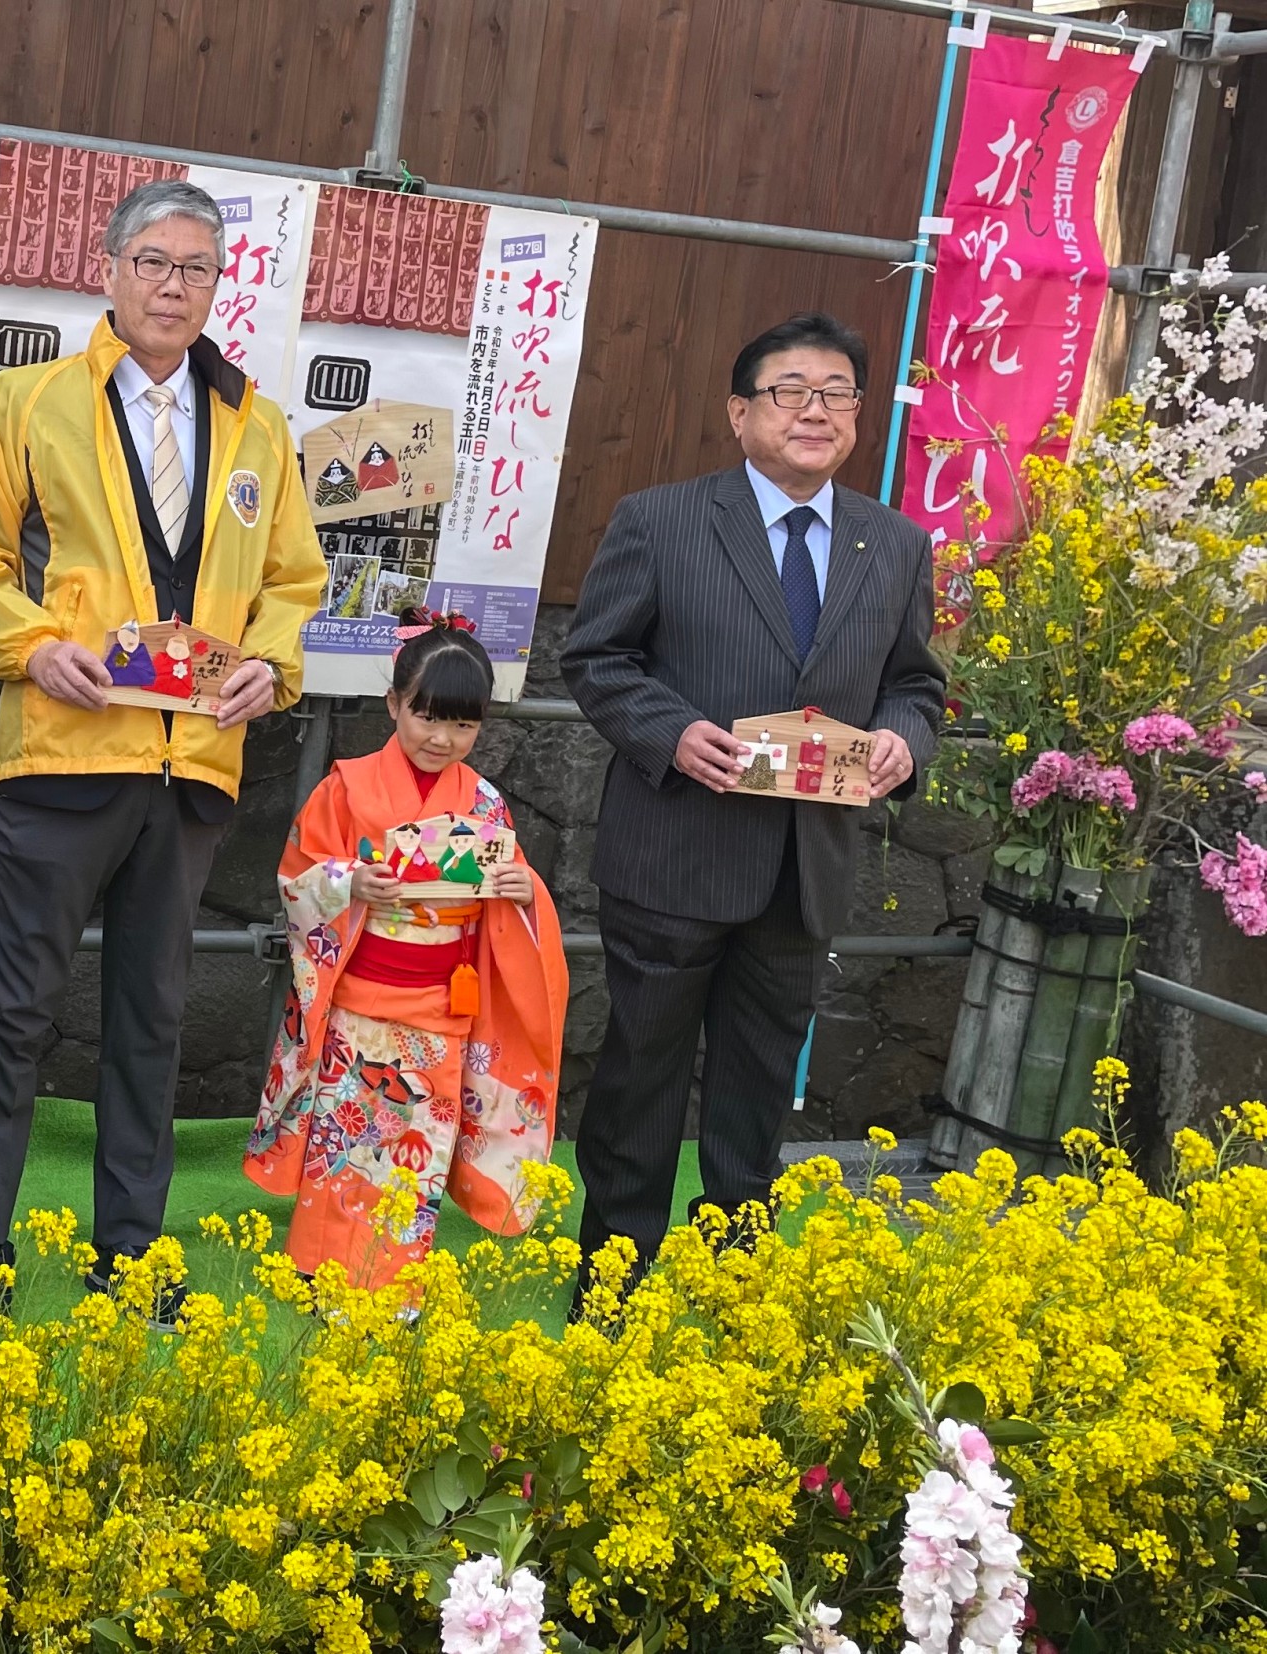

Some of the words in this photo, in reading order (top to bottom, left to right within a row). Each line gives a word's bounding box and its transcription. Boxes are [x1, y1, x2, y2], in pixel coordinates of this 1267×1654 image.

[503, 241, 543, 258] 第37回
[482, 282, 493, 313] ところ
[483, 269, 564, 551] 打吹流しびな
